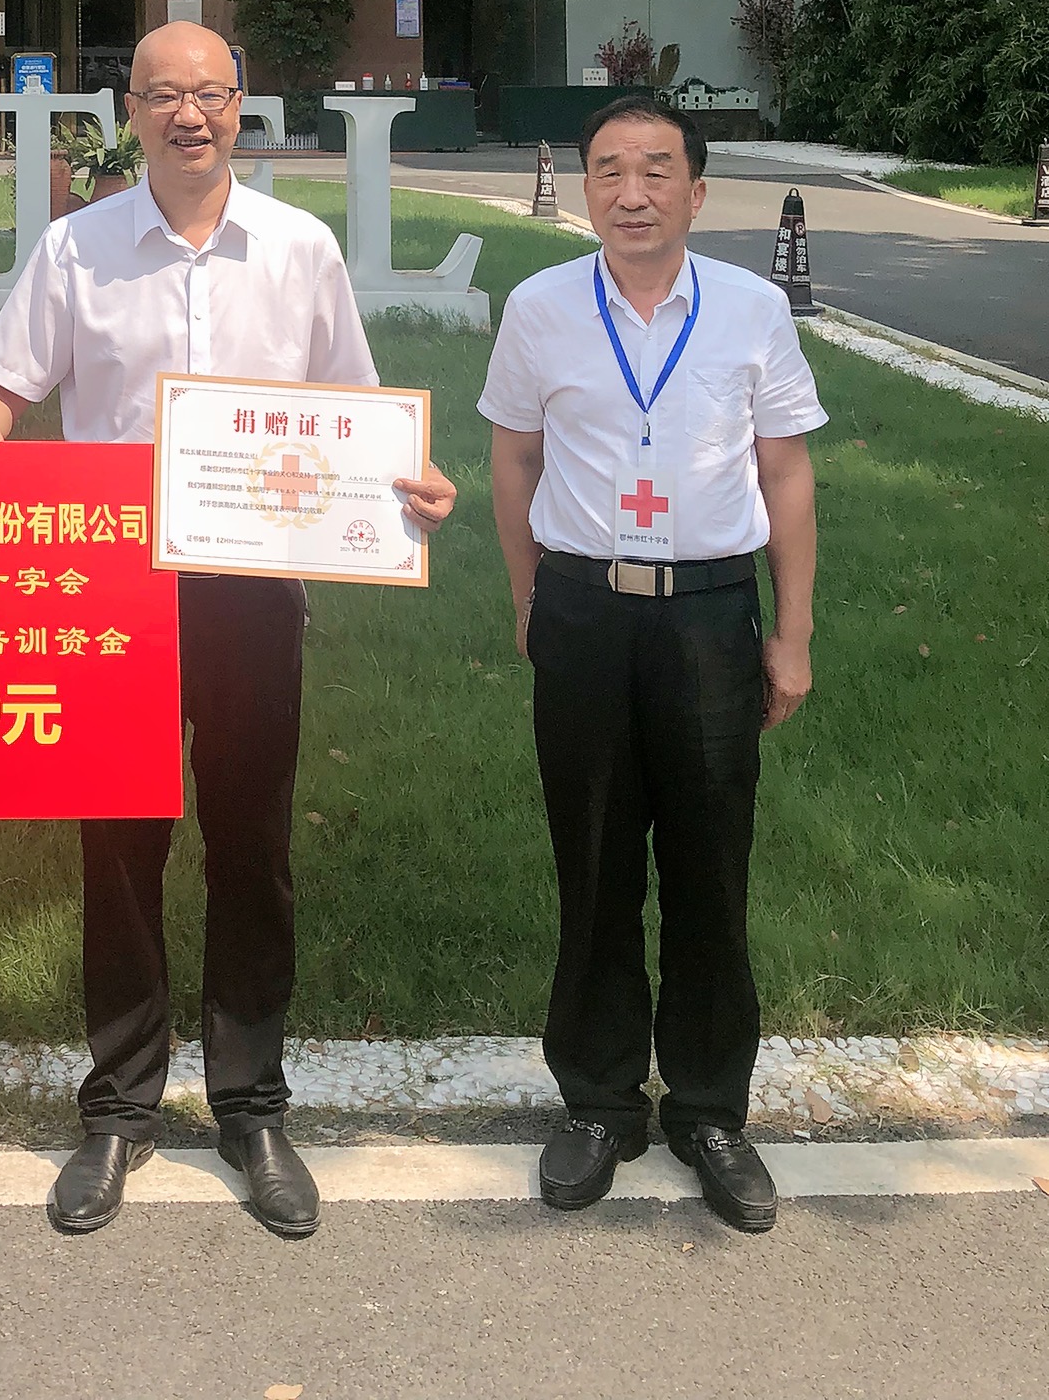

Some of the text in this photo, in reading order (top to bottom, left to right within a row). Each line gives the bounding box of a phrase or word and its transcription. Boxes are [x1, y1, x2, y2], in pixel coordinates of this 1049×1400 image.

[232, 407, 353, 440] 捐赠证书
[619, 533, 669, 545] 鄂州市红十字会
